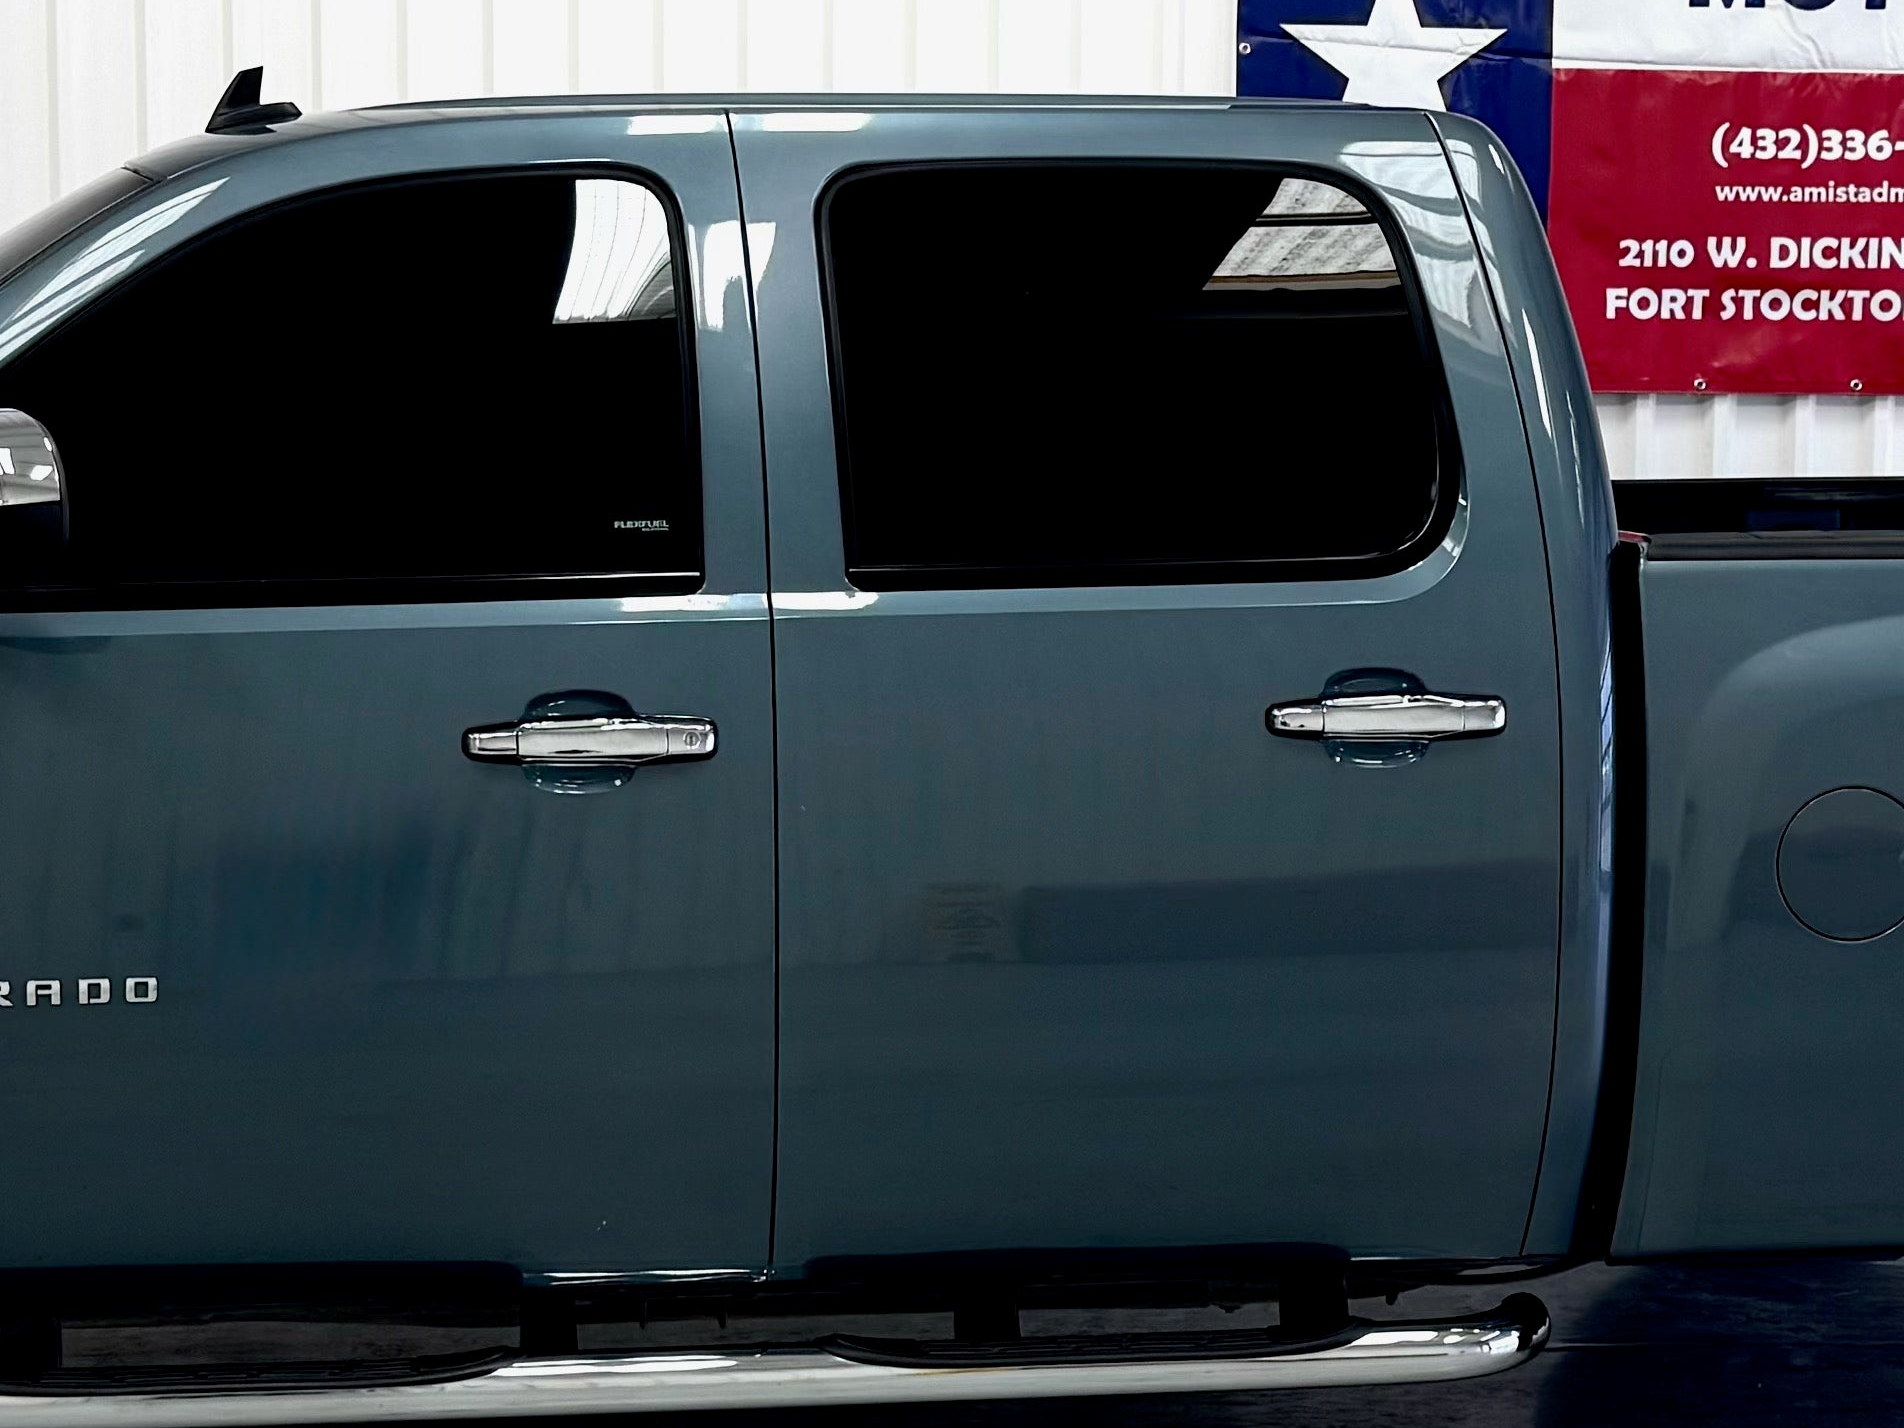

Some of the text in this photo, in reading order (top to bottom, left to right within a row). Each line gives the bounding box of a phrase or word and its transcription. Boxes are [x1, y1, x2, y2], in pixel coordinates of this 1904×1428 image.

[1618, 238, 1695, 268] 2110
[1707, 236, 1758, 269] W.
[1605, 287, 1710, 320] FORT
